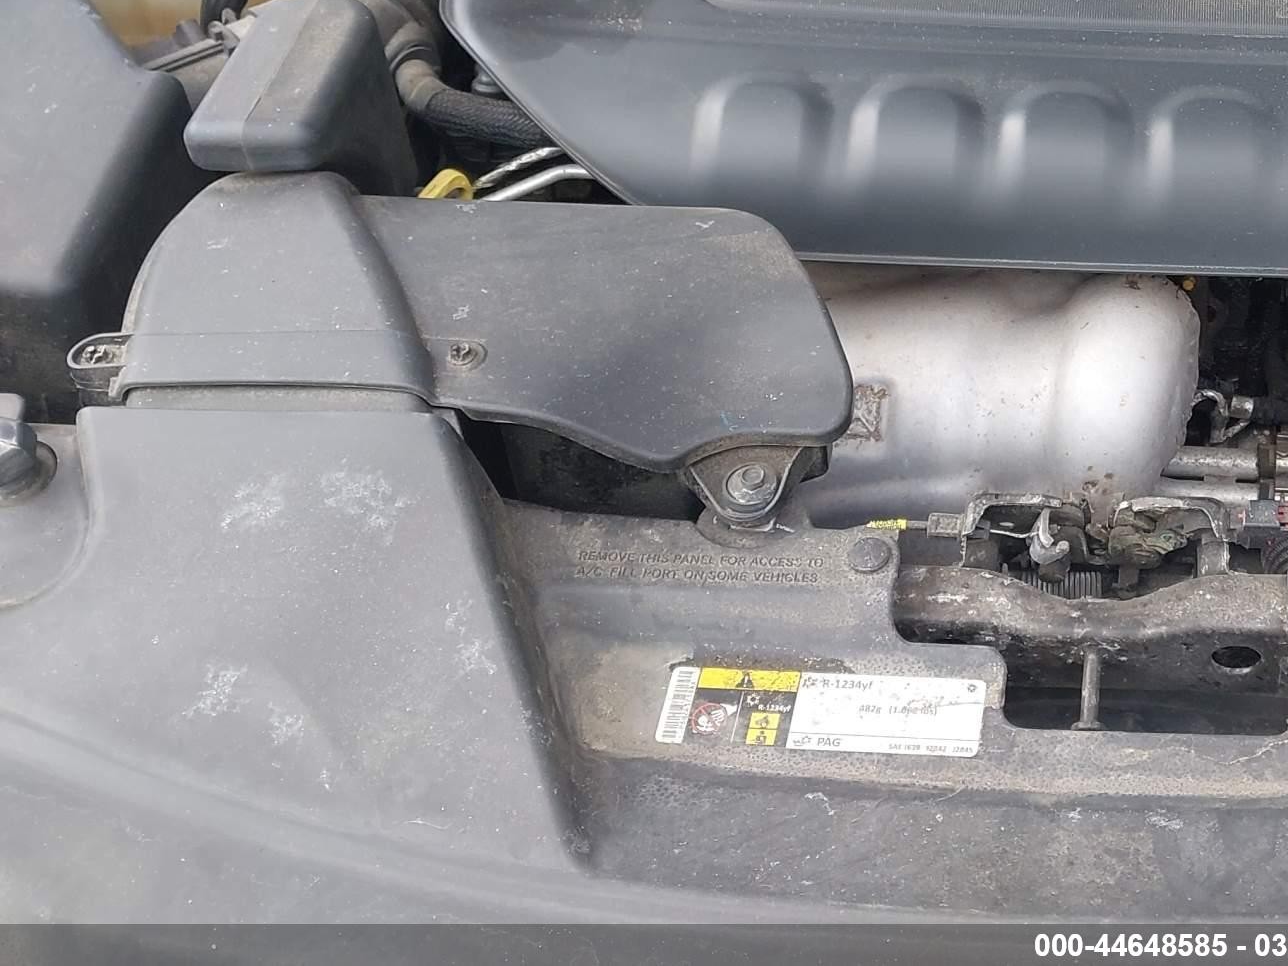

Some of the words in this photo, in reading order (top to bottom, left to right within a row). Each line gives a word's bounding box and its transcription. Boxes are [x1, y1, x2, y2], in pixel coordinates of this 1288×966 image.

[578, 550, 636, 562] REMOVE
[639, 552, 670, 564] THIS
[673, 554, 715, 566] PANEL
[719, 555, 746, 567] FOR
[750, 556, 802, 568] ACCESS
[807, 556, 824, 568] TO
[575, 565, 603, 578] A/C
[609, 566, 638, 579] FILL
[642, 568, 679, 580] PORT
[684, 569, 705, 581] ON
[707, 570, 748, 582] SOME
[752, 570, 819, 584] VEHICLES
[822, 678, 873, 691] R-1234yf
[757, 703, 792, 714] R-1234yf
[816, 737, 841, 747] PAG
